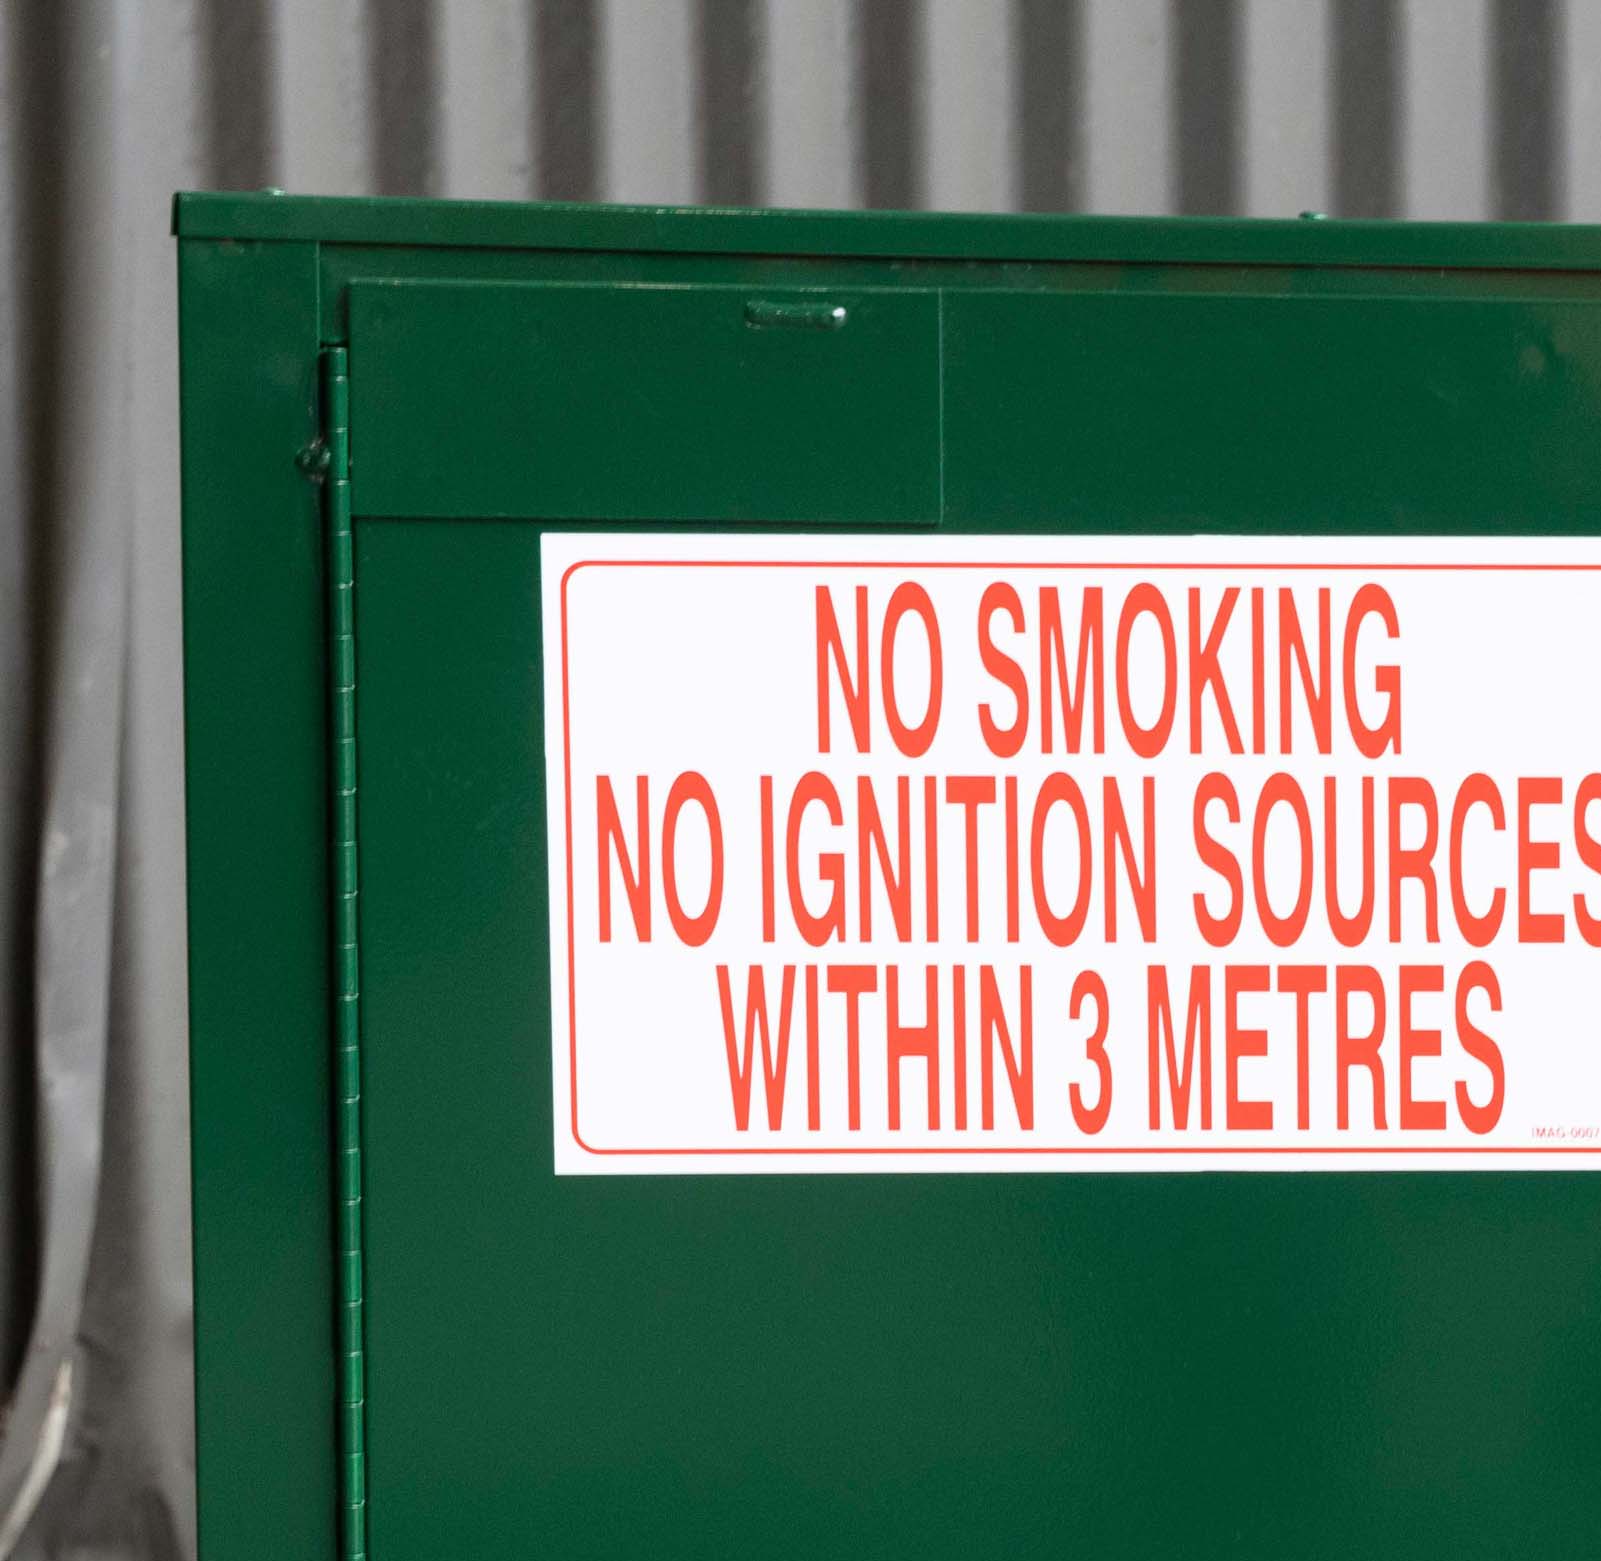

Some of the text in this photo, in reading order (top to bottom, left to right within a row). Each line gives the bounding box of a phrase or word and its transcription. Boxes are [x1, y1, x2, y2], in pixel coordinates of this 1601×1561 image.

[816, 582, 1401, 759] NO SMOKING
[597, 771, 724, 947] NO
[760, 771, 1156, 947] IGNITION
[716, 961, 1505, 1135] WITHIN 3 METRES
